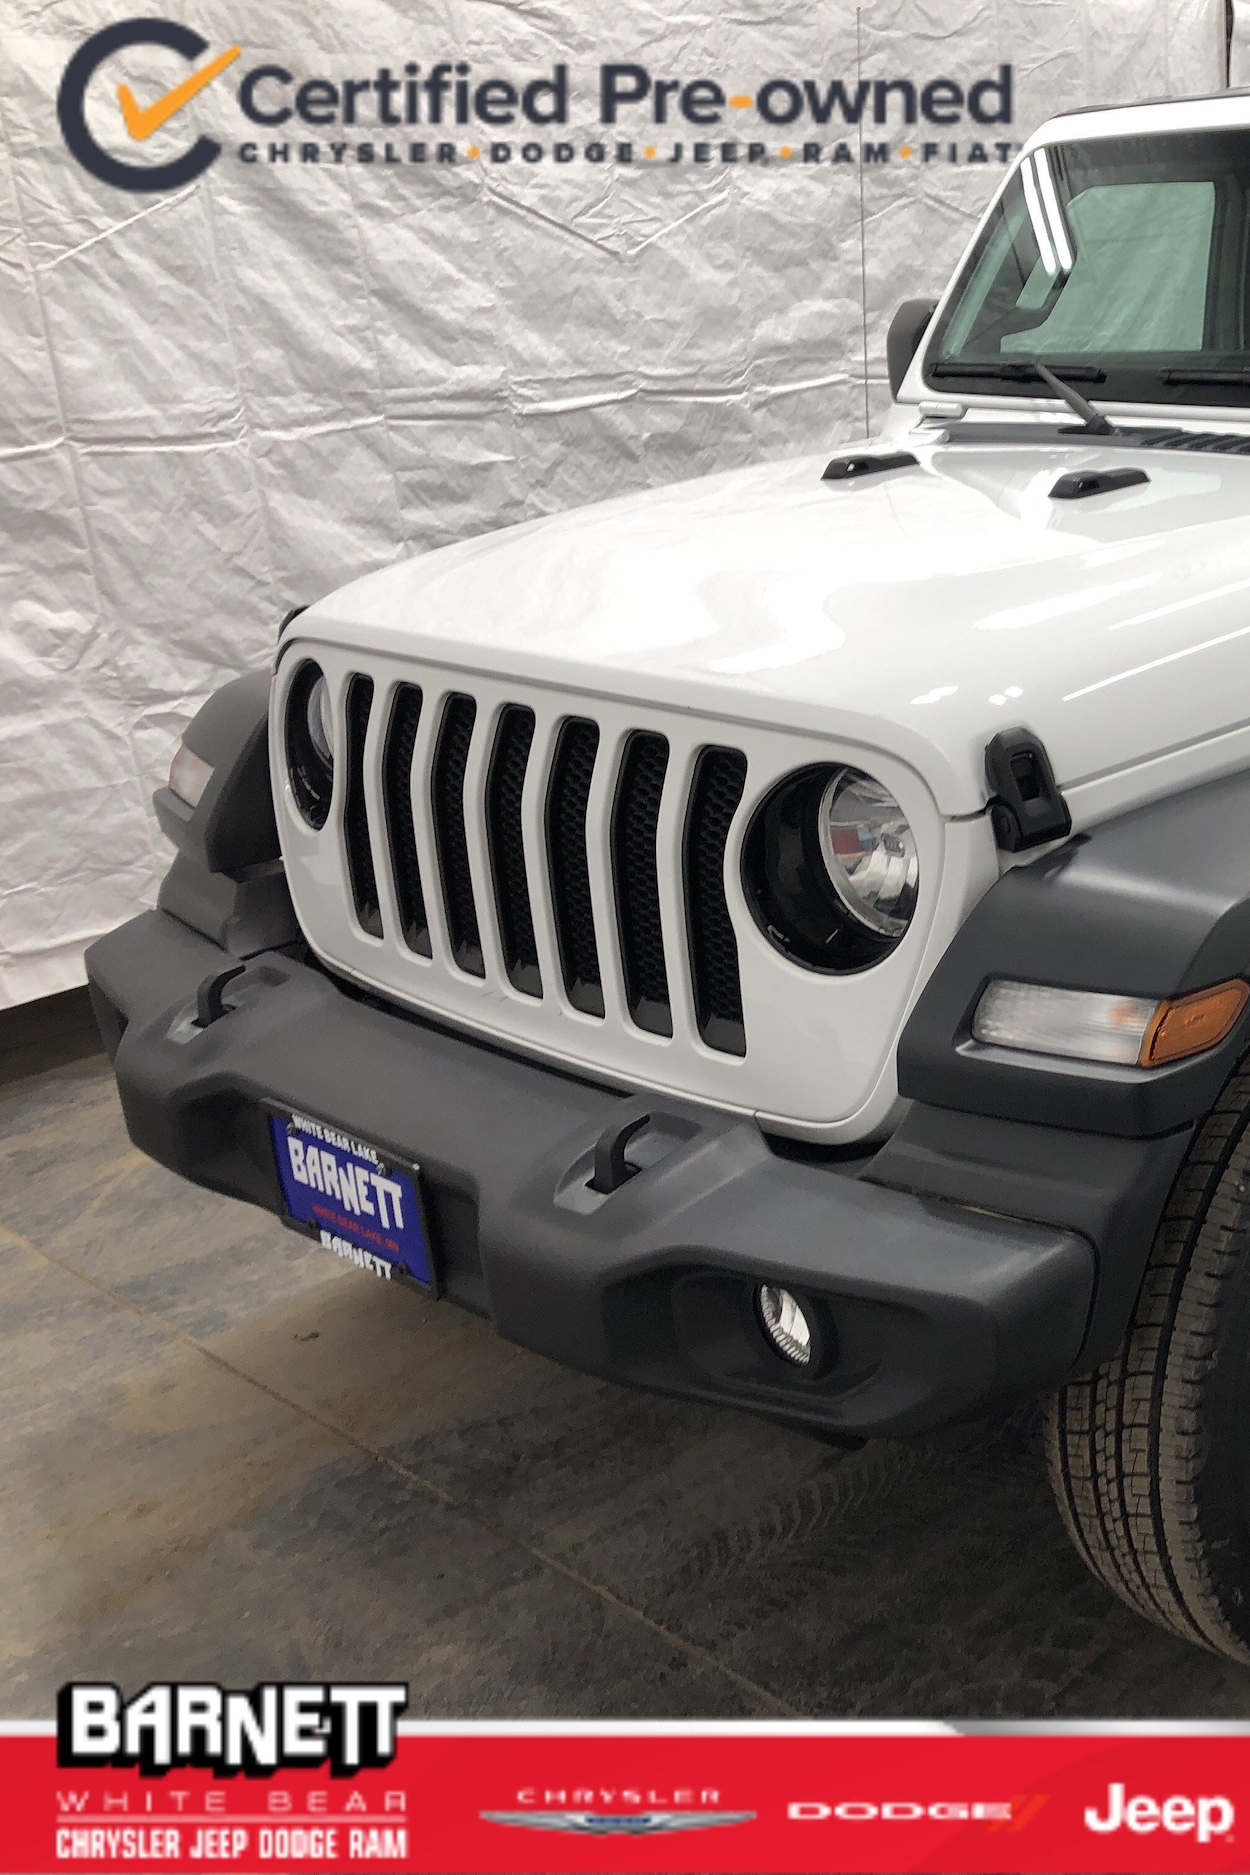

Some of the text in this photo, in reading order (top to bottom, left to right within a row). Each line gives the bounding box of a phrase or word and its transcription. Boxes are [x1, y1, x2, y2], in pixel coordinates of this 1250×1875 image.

[292, 1113, 379, 1165] WHITE BEAR LAKE
[287, 1136, 404, 1230] BARNETT
[320, 1229, 392, 1280] BARNETT
